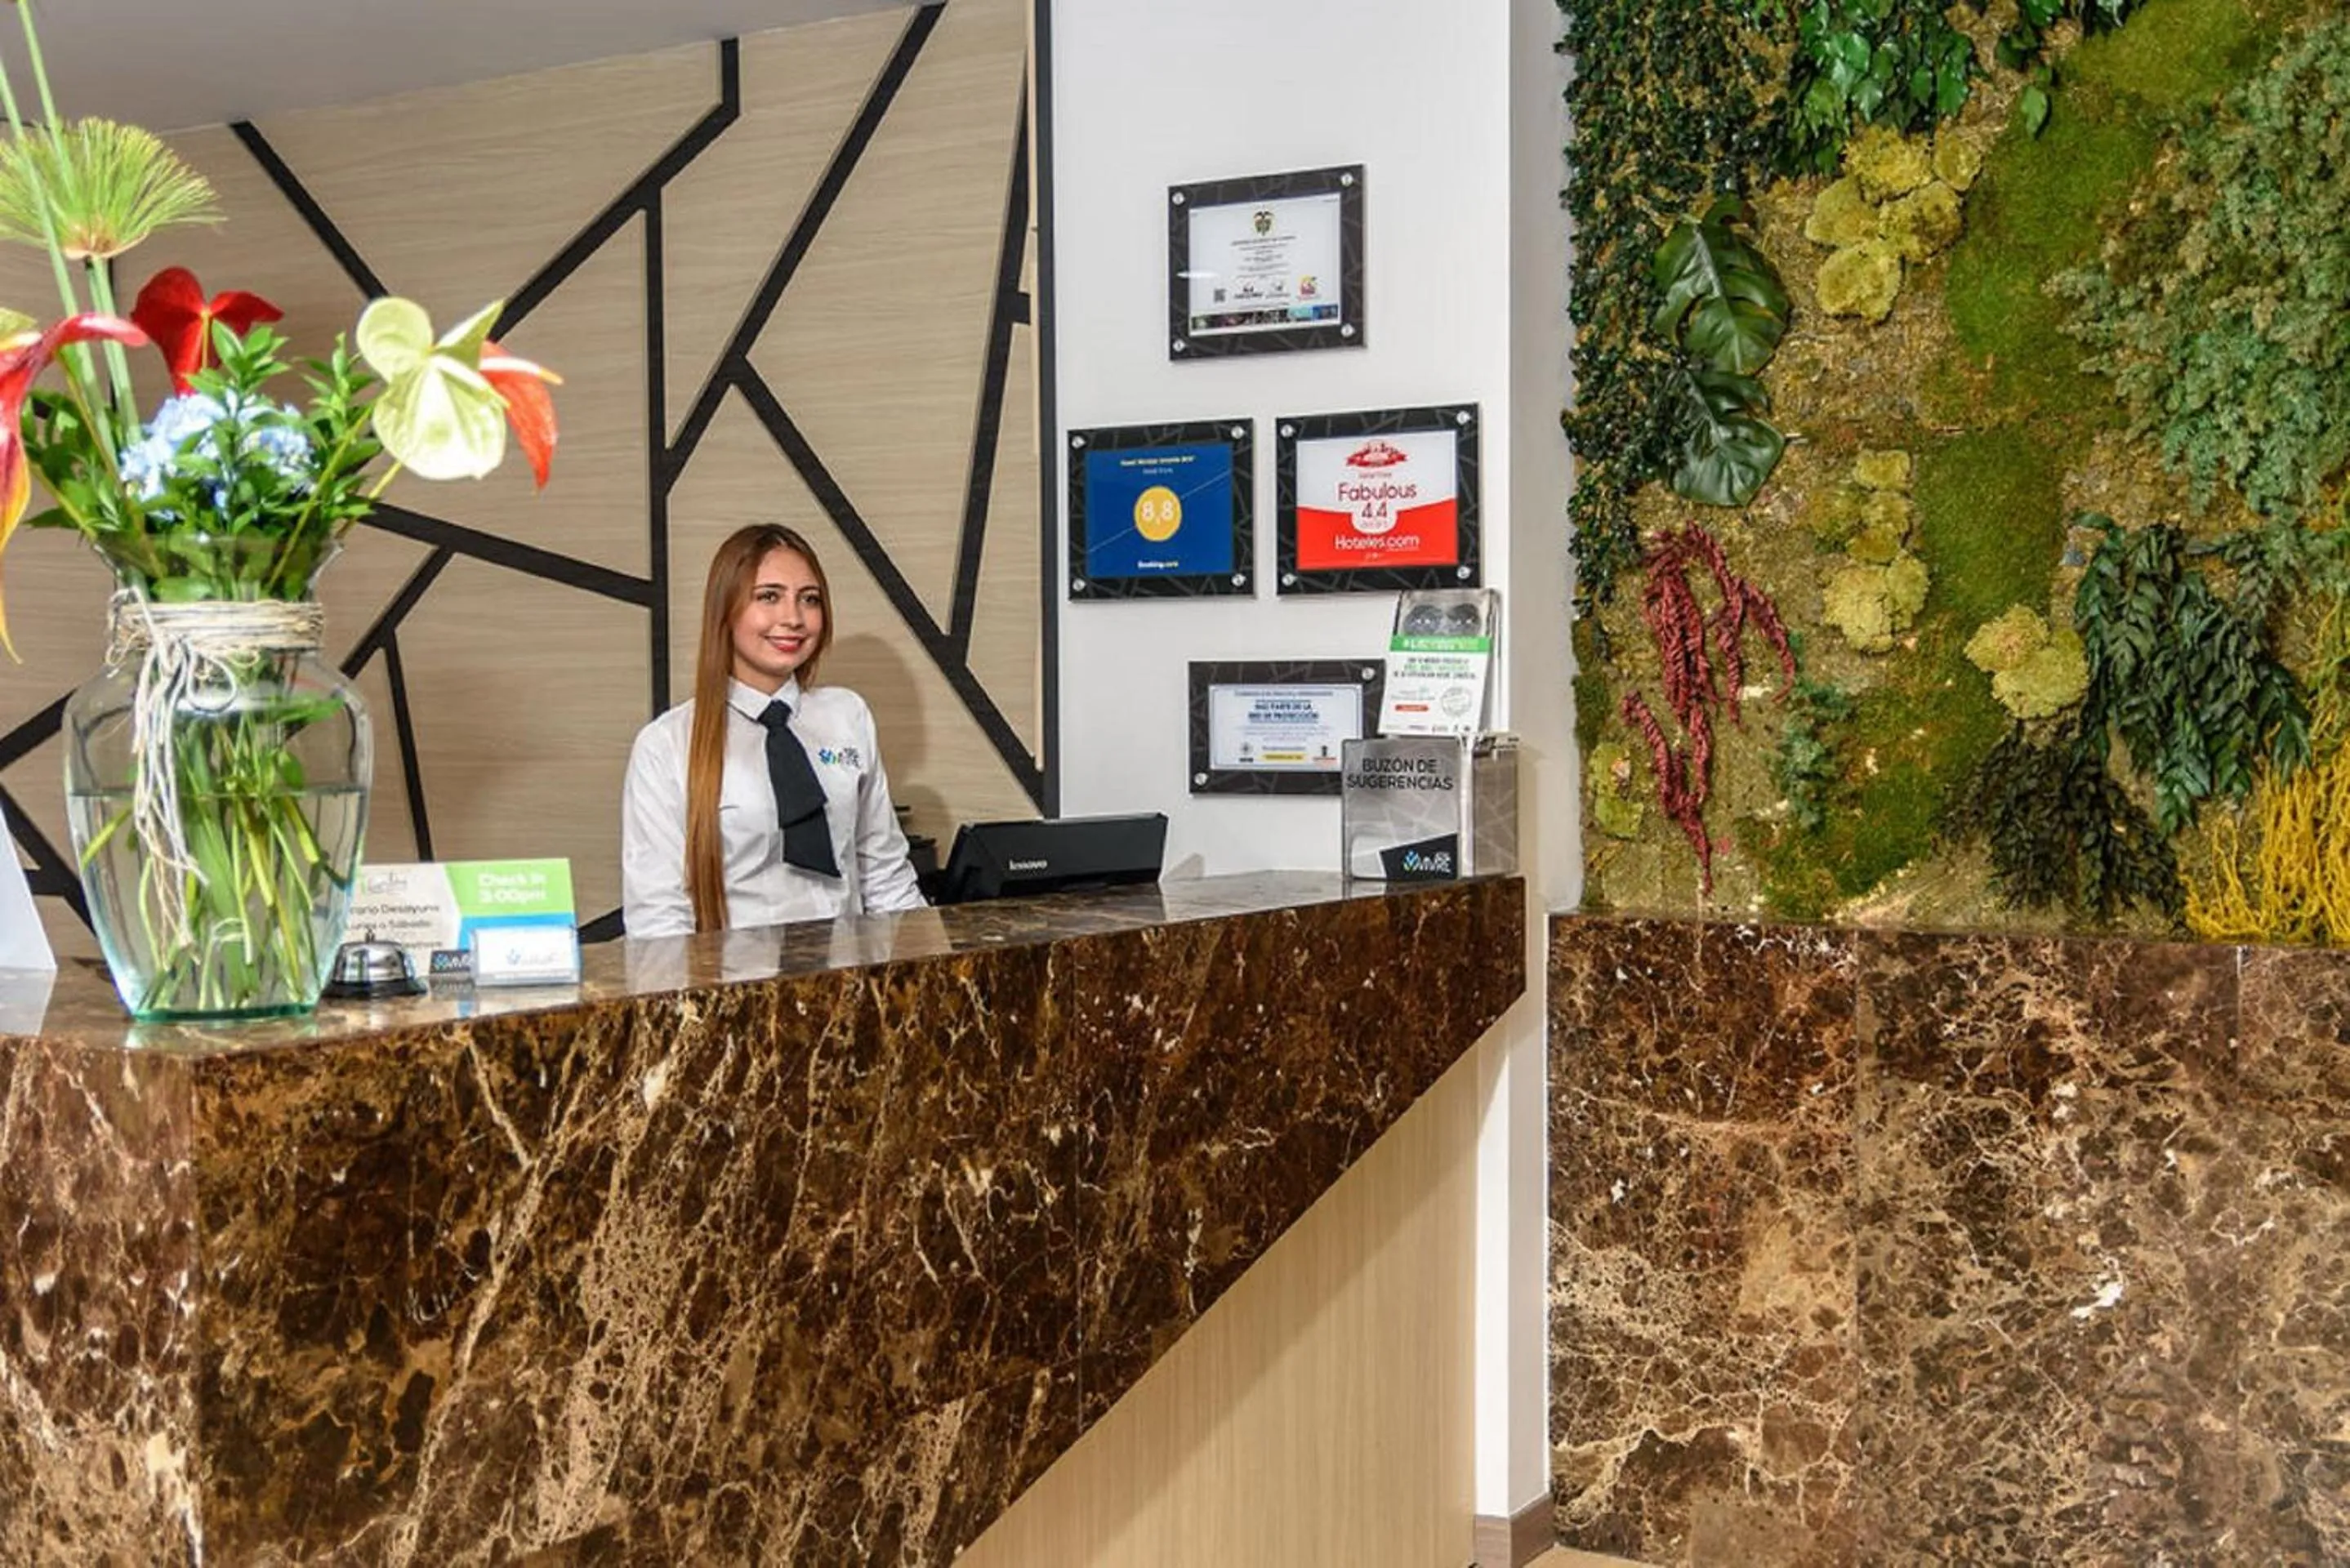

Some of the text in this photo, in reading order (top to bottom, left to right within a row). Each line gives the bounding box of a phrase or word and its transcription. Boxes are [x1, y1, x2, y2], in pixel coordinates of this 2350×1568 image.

[1338, 482, 1417, 501] Fabulous
[1335, 534, 1420, 551] Hoteles.com
[1418, 758, 1438, 773] DE
[1347, 774, 1453, 790] SUGERENCIAS
